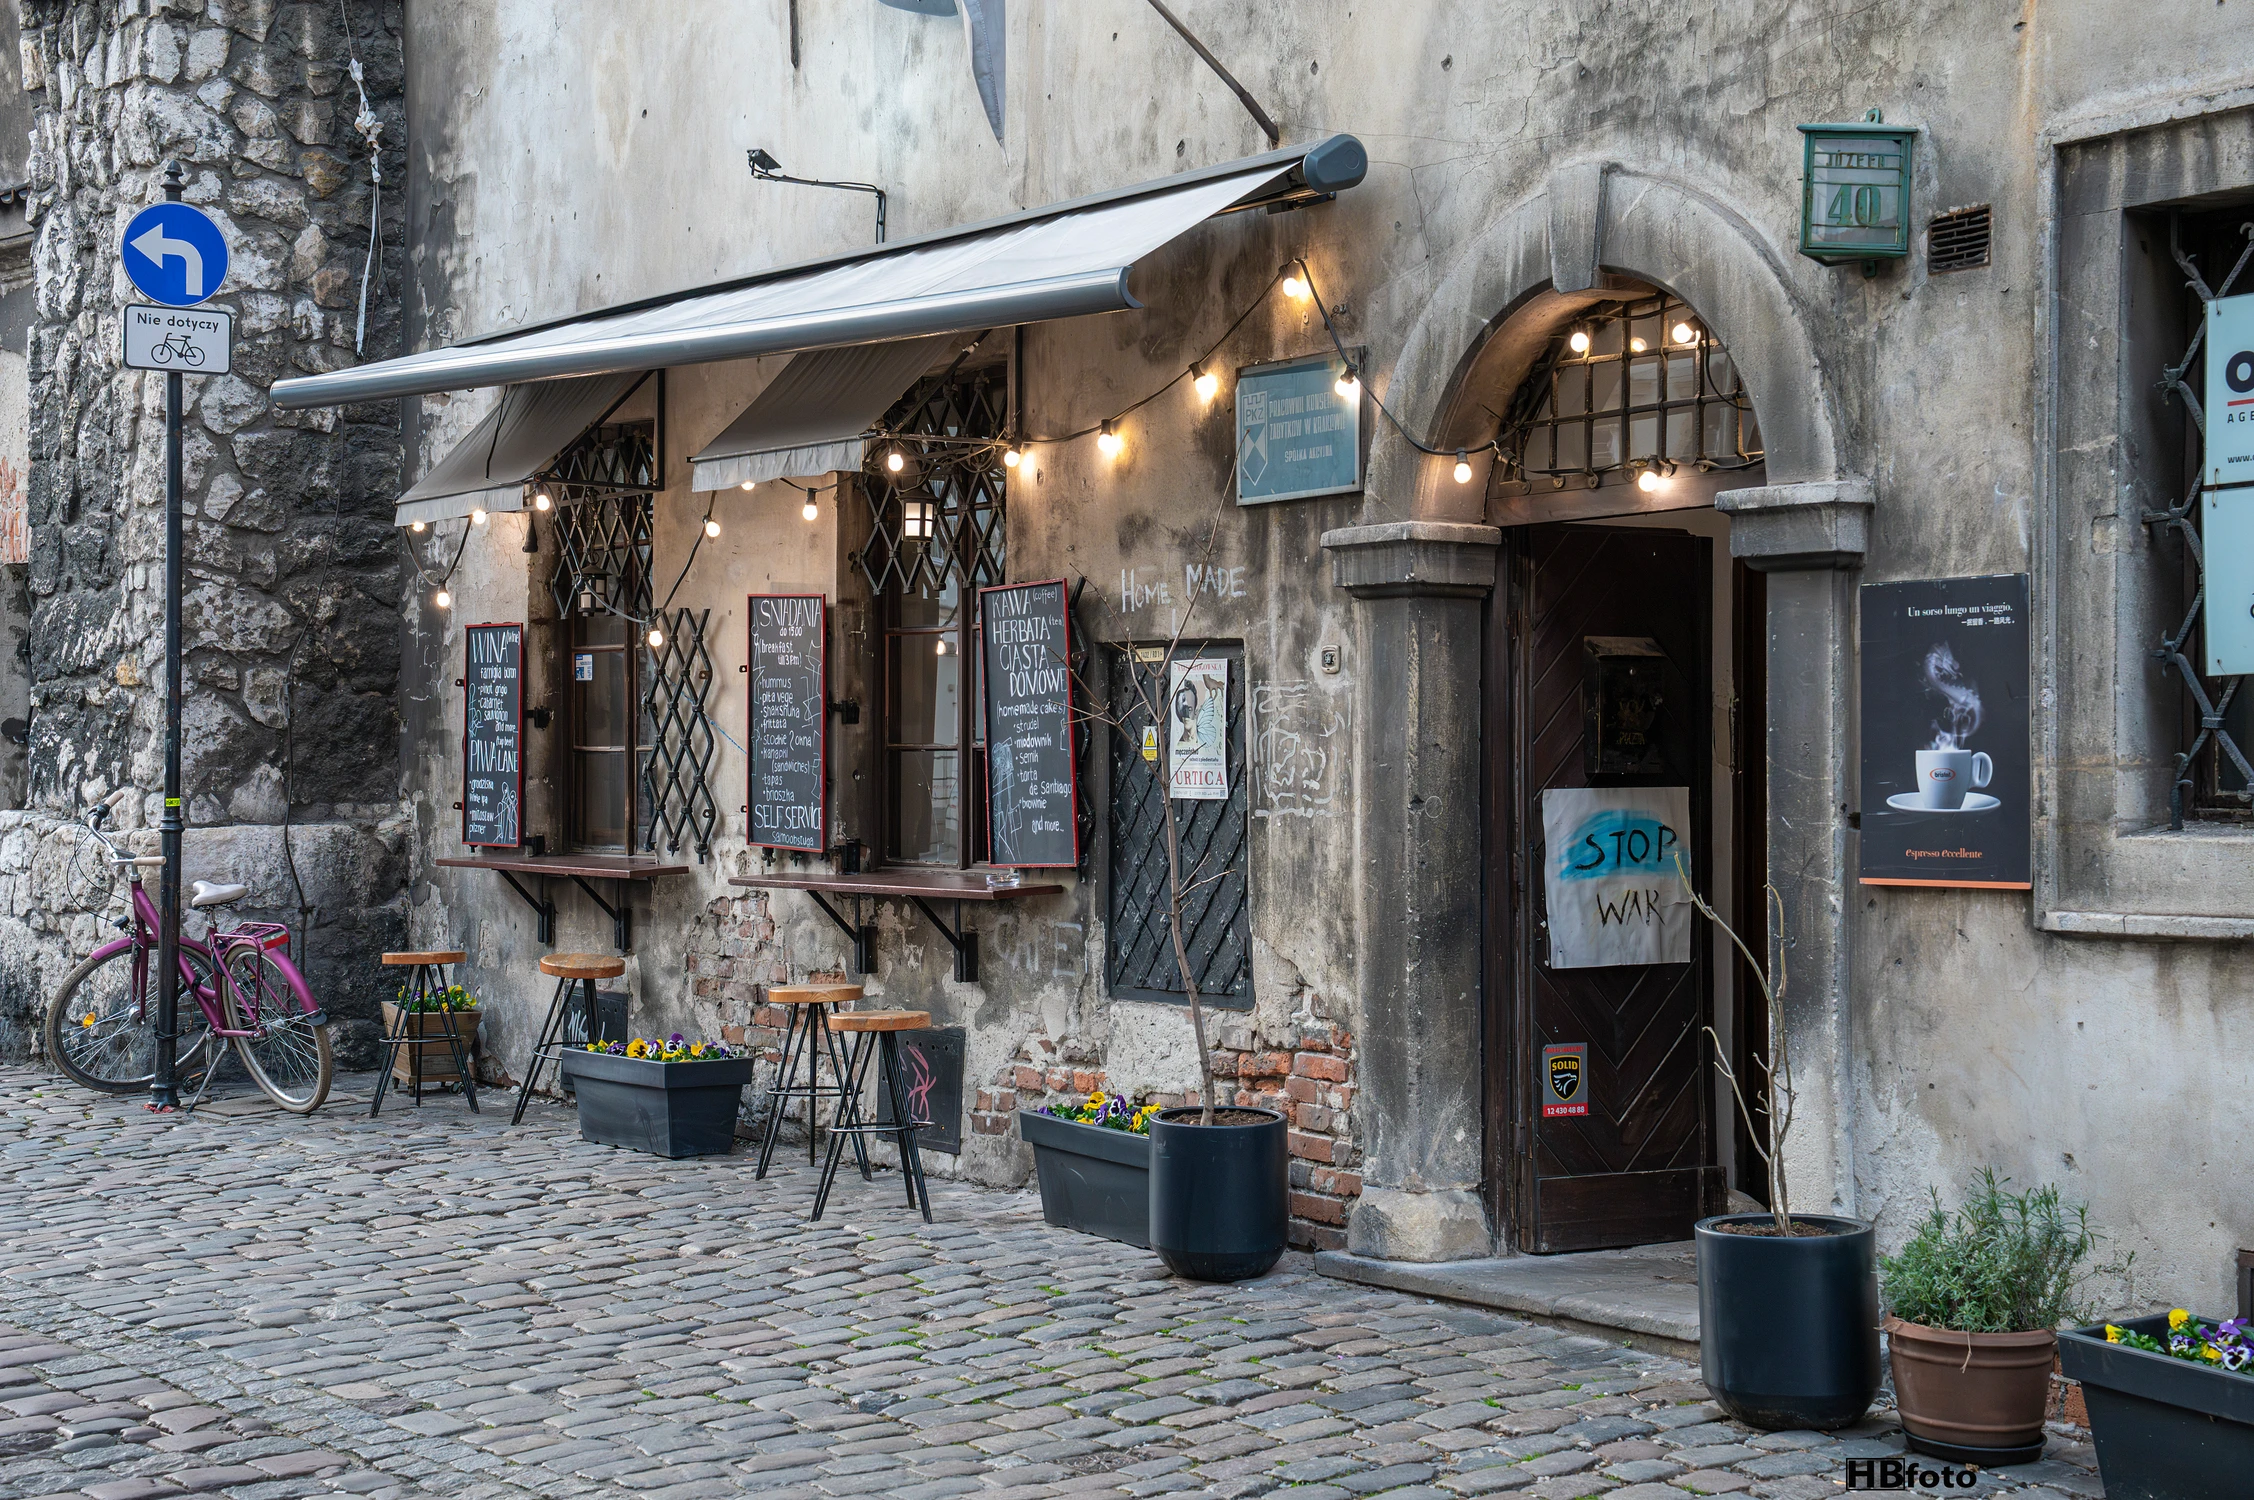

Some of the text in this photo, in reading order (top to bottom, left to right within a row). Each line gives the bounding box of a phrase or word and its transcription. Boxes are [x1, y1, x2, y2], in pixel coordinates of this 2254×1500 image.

[1828, 184, 1881, 226] 40
[137, 312, 219, 333] Nie dotyczy
[1246, 407, 1264, 422] PKZ
[1304, 415, 1312, 435] W
[1309, 444, 1333, 459] AKCYJNA
[1186, 563, 1247, 598] MADE
[992, 587, 1057, 618] KAWA (coffee)
[1908, 602, 2013, 617] Un sorso lungo un viaggio.
[779, 626, 788, 637] do
[993, 614, 1065, 644] HERBATA (tea)
[472, 631, 508, 663] WINA
[759, 638, 793, 654] (breakfast
[999, 644, 1050, 672] CIASTA
[761, 676, 792, 689] hummus
[1010, 668, 1068, 697] DOMOWE
[762, 691, 794, 707] pita vege
[763, 718, 787, 733] frittata
[1016, 717, 1040, 733] strudel
[1016, 733, 1052, 749] miodownik
[470, 739, 519, 773] PIWA LANE
[763, 747, 789, 759] kanapki
[763, 773, 783, 786] tapas
[1175, 770, 1224, 786] URTICA
[765, 788, 795, 802] brioszka
[1029, 779, 1072, 798] de Santiago
[1022, 796, 1047, 810] brownie
[754, 803, 784, 829] SELF
[1031, 815, 1043, 835] and
[1575, 824, 1677, 870] STOP
[1905, 847, 1983, 860] espresso eccellente
[1596, 889, 1666, 928] WAR
[1552, 1060, 1578, 1071] SOLID
[1547, 1105, 1585, 1115] 12 430 48 88
